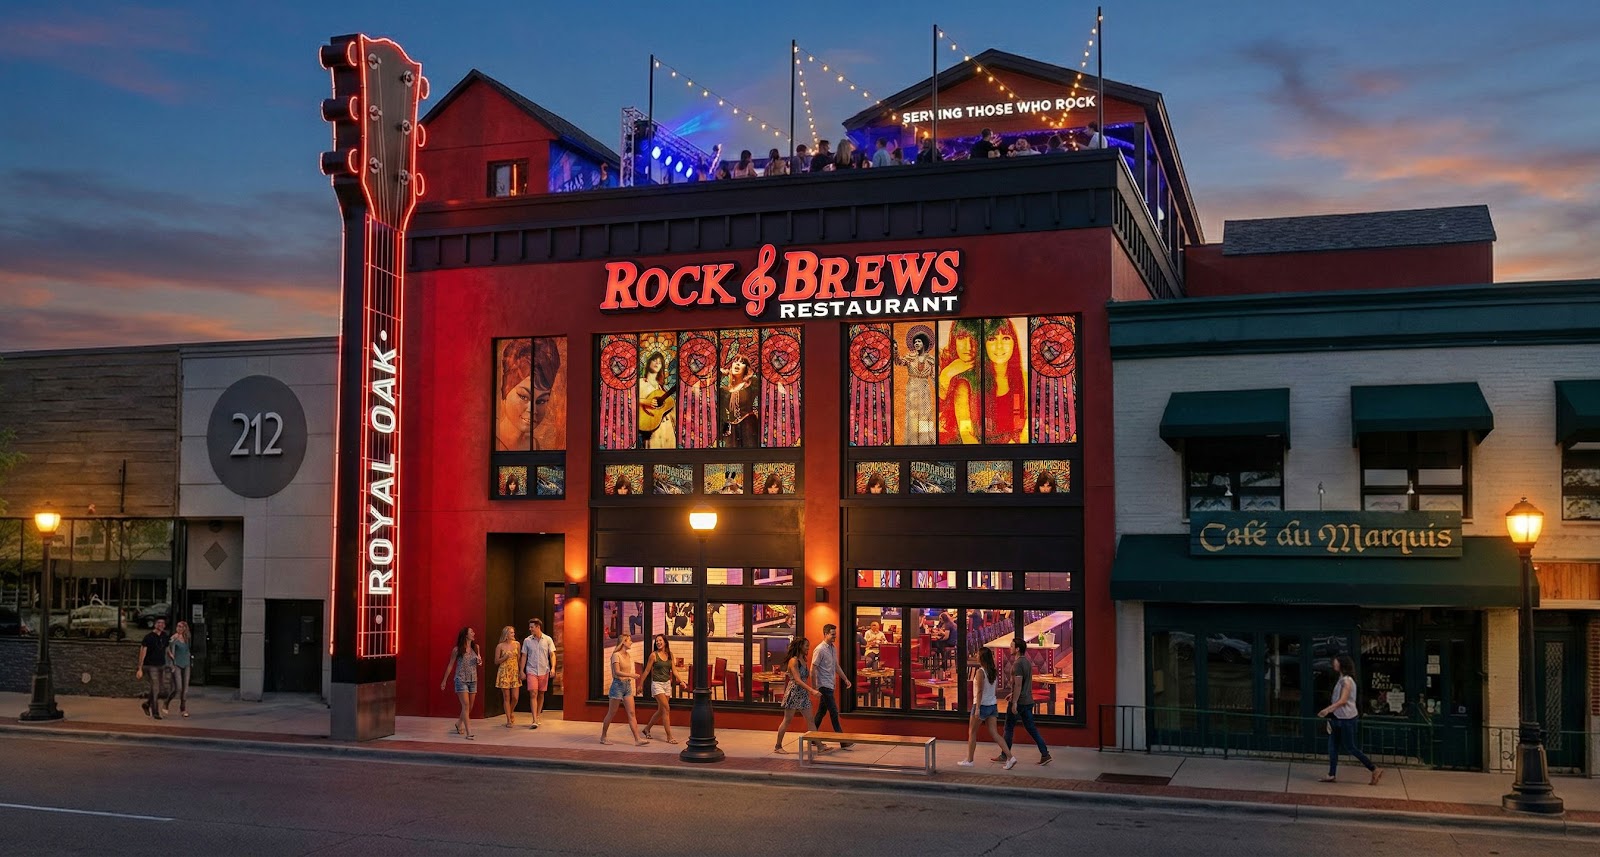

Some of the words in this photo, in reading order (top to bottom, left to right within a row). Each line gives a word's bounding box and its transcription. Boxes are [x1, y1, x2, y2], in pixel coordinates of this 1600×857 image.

[903, 107, 963, 123] SERVING
[966, 103, 1013, 118] THOSE
[1016, 99, 1051, 114] WHO
[1055, 95, 1096, 110] ROCK
[600, 261, 737, 310] ROCK
[778, 250, 961, 301] BREWS
[780, 296, 958, 318] RESTAURANT
[370, 341, 398, 434] OAK
[229, 411, 284, 456] 212
[368, 453, 396, 595] ROYAL
[1199, 519, 1268, 552] Café
[1276, 519, 1312, 547] du
[1318, 522, 1453, 555] Marquis
